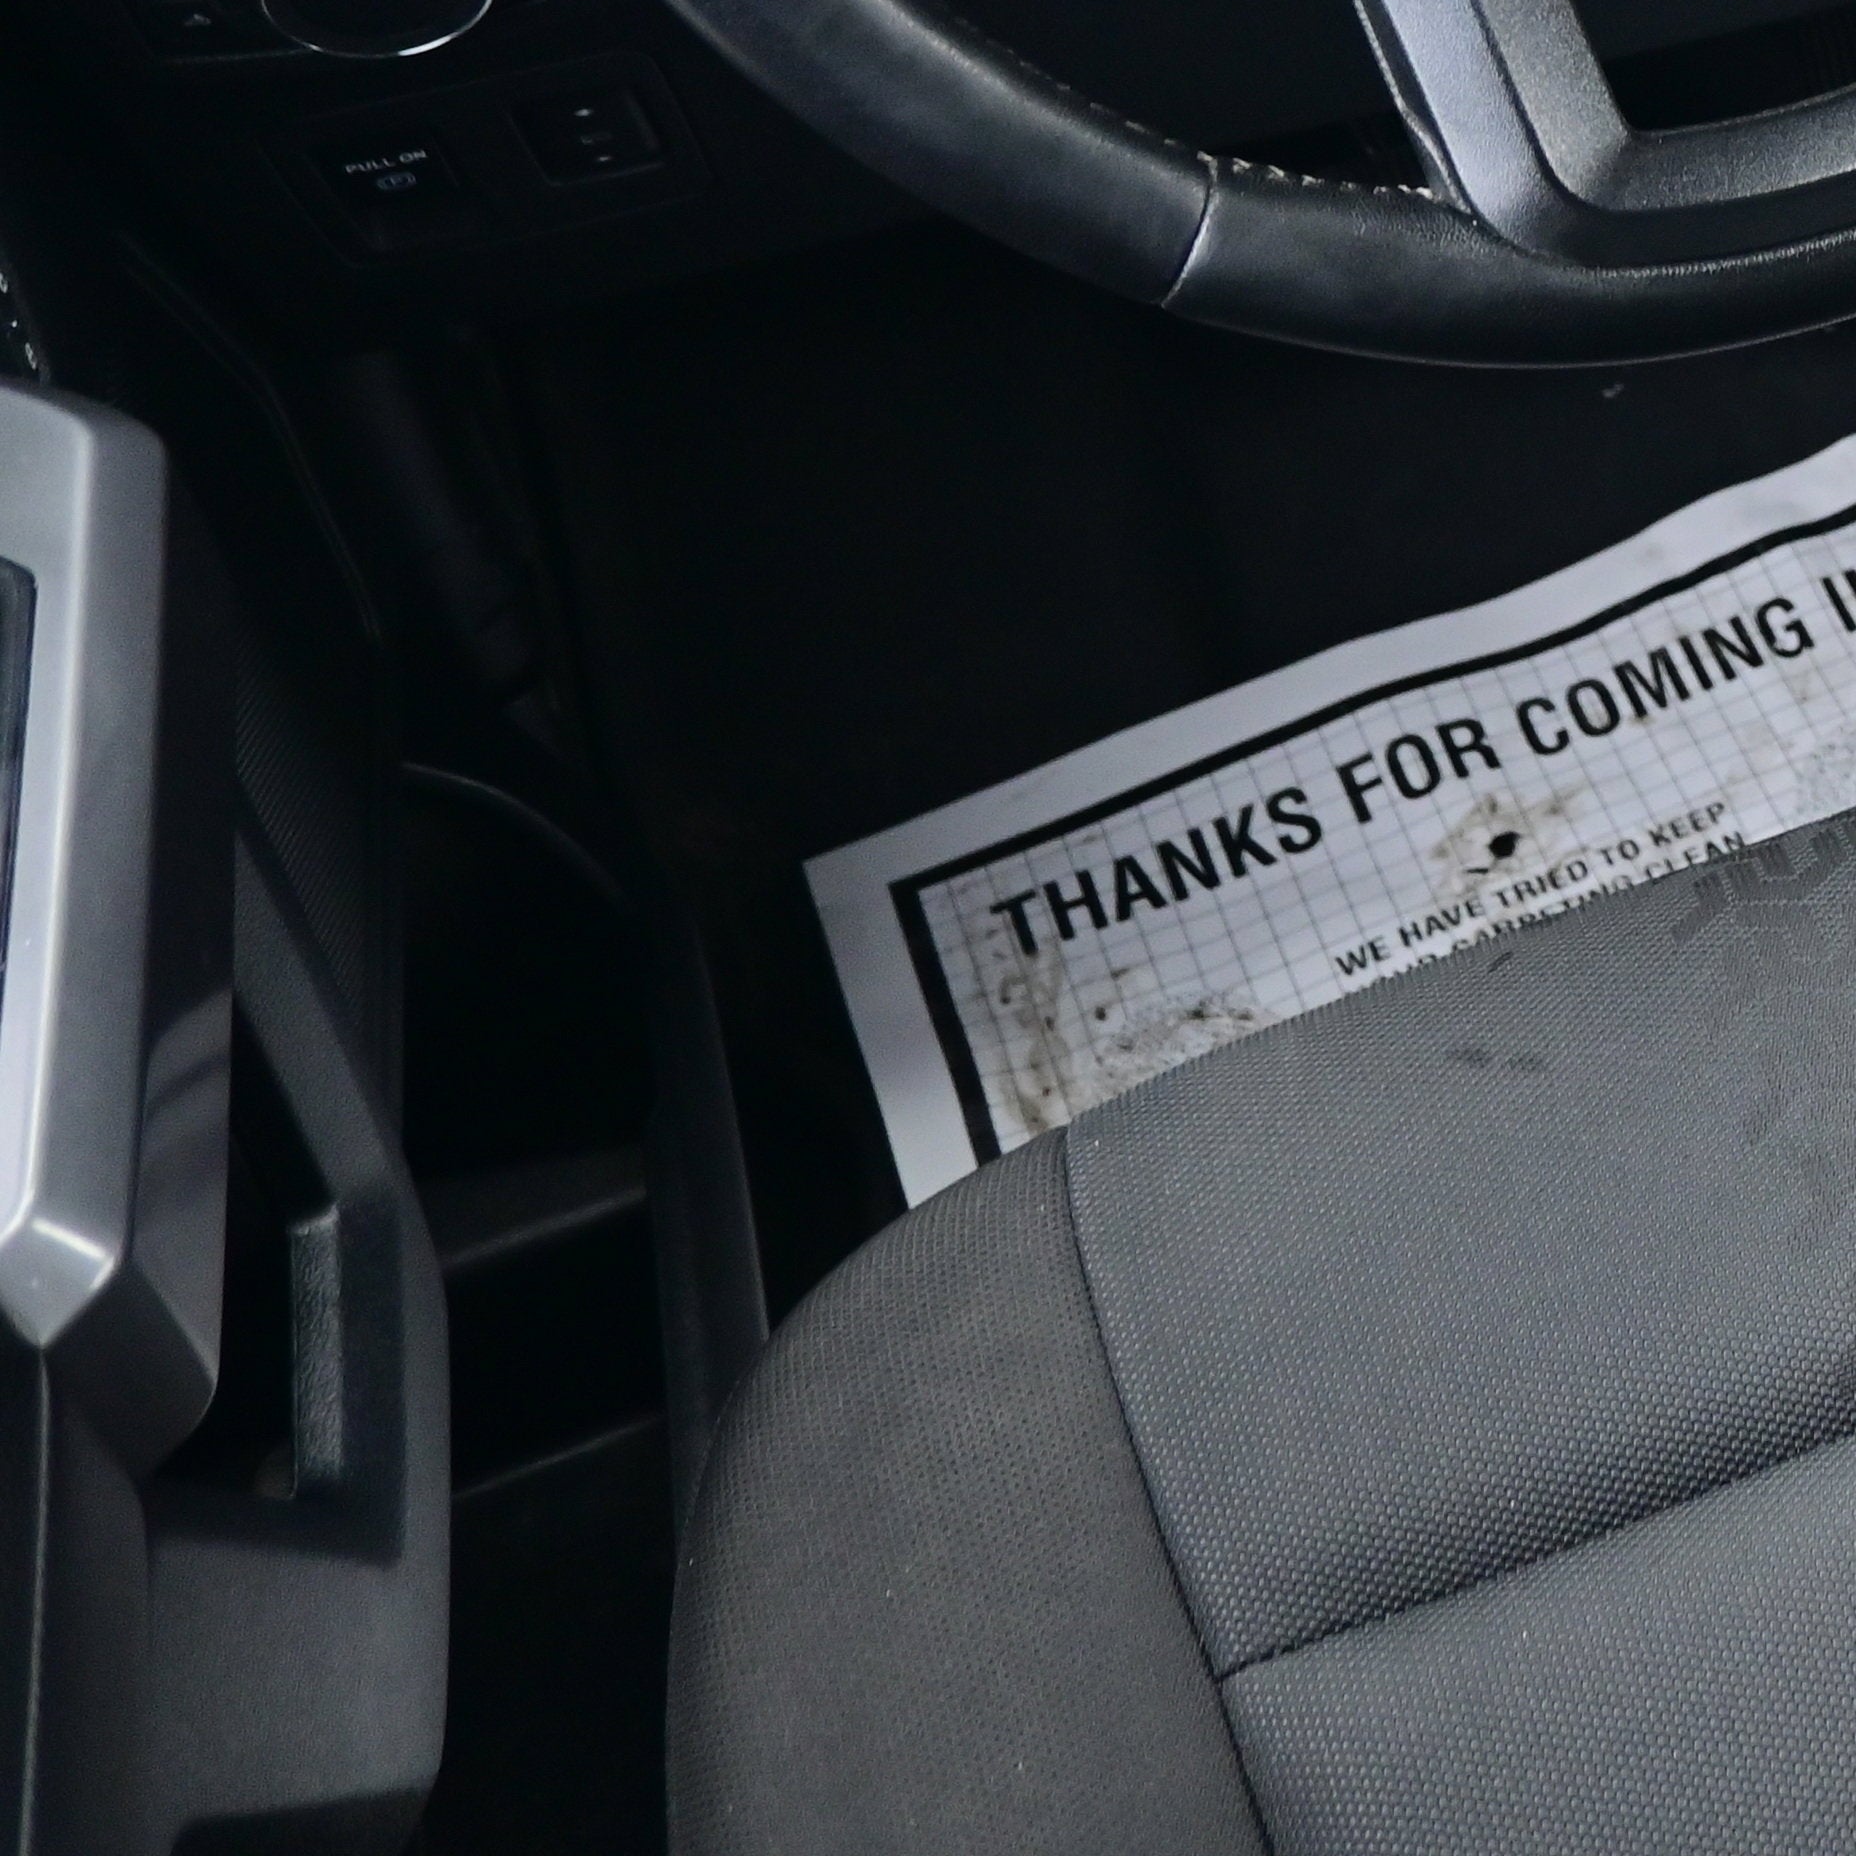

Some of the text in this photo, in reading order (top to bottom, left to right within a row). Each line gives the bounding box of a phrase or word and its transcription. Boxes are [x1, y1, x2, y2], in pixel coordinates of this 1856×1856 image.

[345, 157, 395, 173] PULL
[990, 786, 1322, 956] THANKS
[1336, 718, 1501, 825] FOR
[1515, 597, 1815, 756] COMING
[1335, 935, 1391, 977] WE
[1398, 896, 1486, 947] HAVE
[1495, 859, 1589, 908] TRIED
[1601, 838, 1640, 867] TO
[1648, 801, 1727, 847] KEEP
